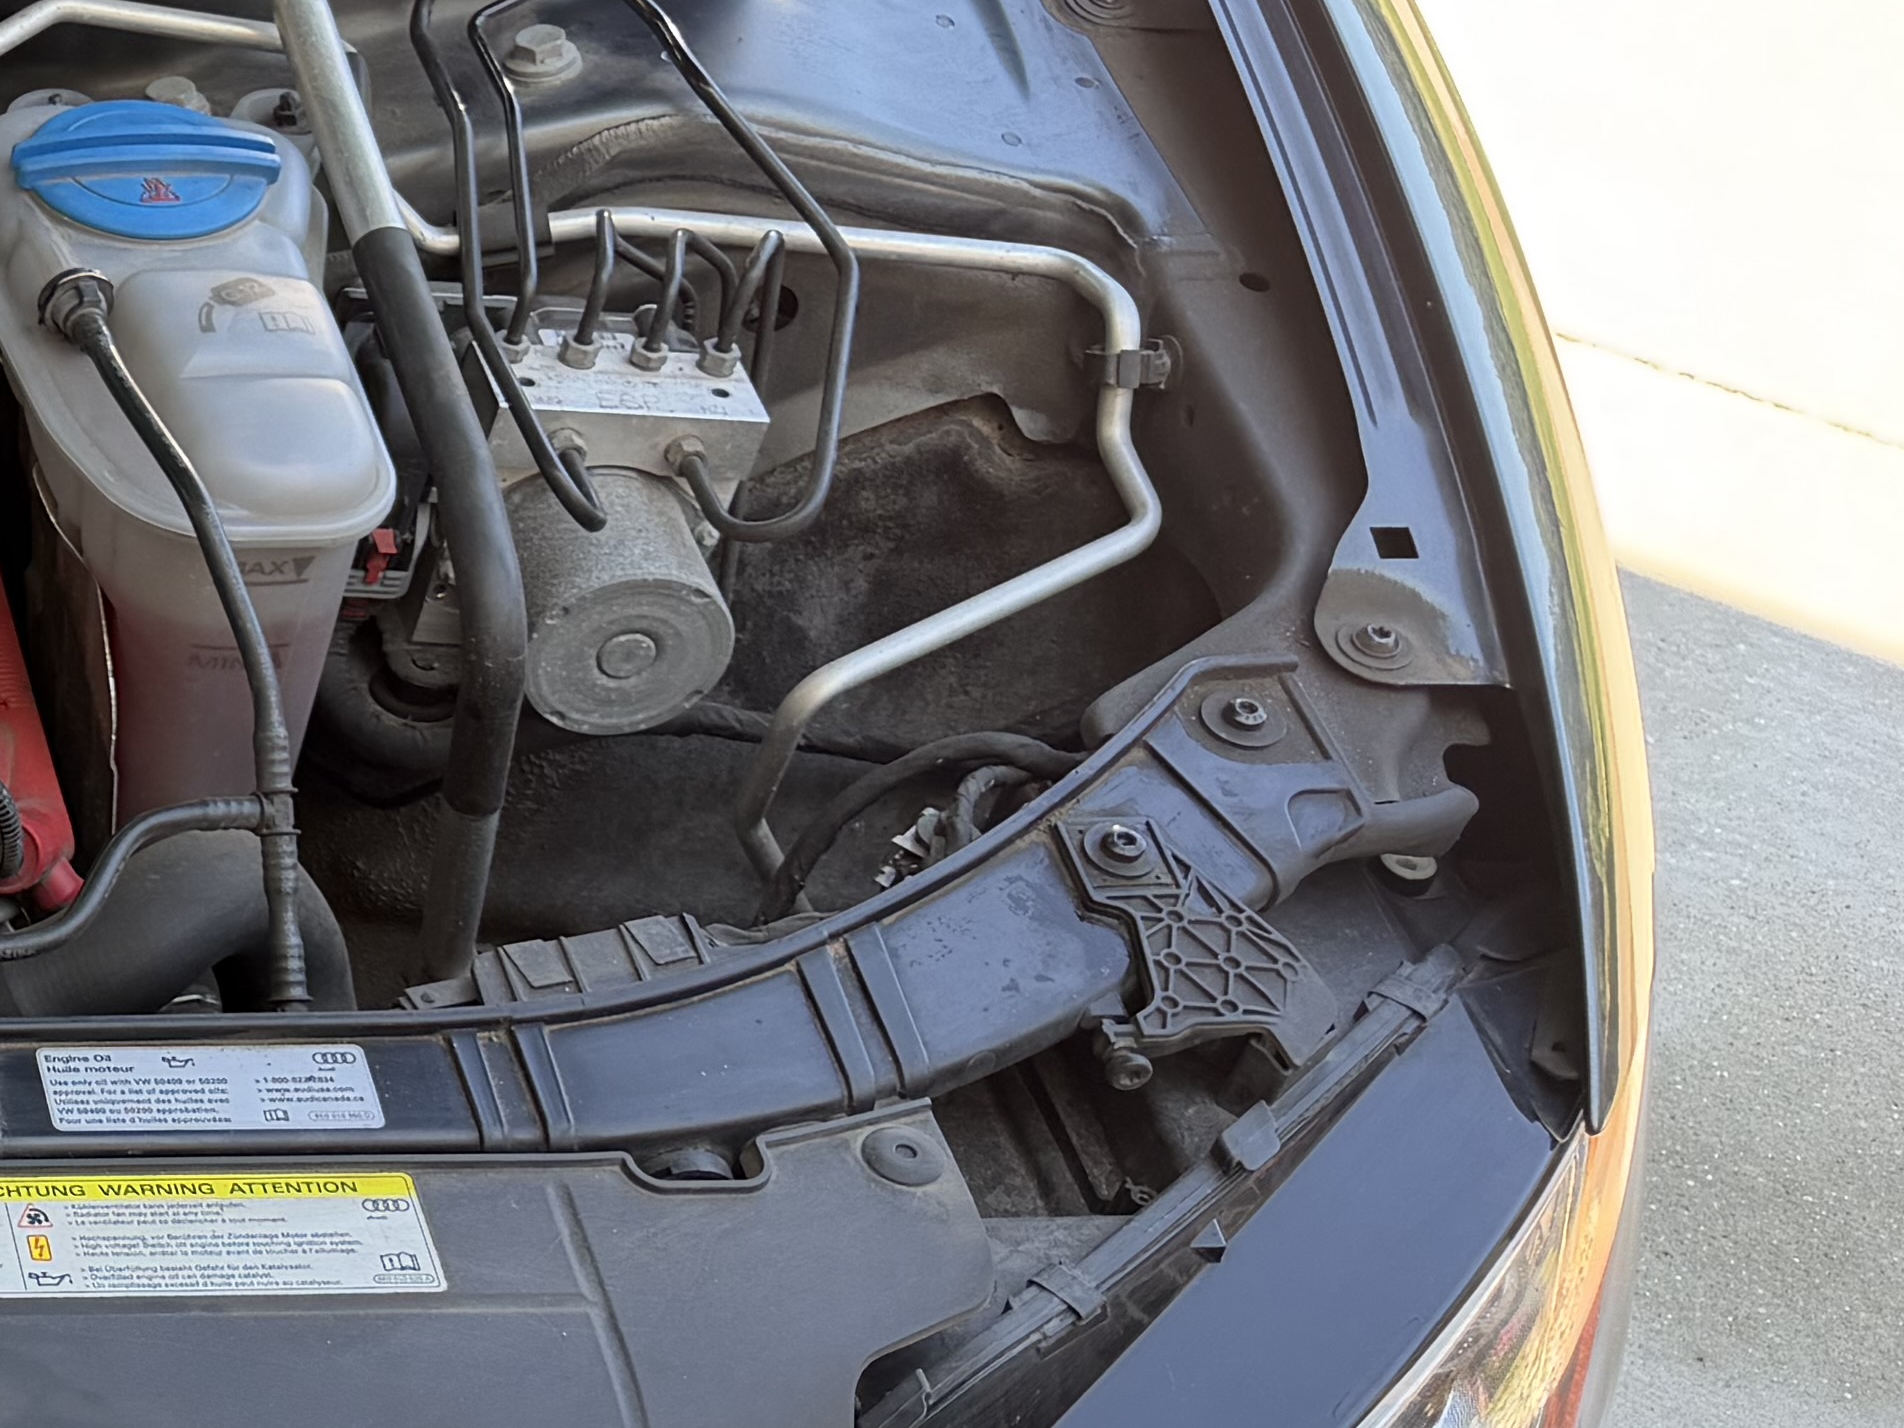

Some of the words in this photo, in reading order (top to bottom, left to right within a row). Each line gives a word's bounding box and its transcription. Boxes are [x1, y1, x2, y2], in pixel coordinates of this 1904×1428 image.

[44, 1054, 90, 1064] Engine
[93, 1054, 112, 1062] Oil
[46, 1065, 80, 1073] Huile
[84, 1065, 135, 1073] moteur
[133, 1077, 152, 1085] VW
[57, 1107, 74, 1115] VW
[98, 1182, 215, 1196] WARNING
[229, 1180, 358, 1195] ATTENTION
